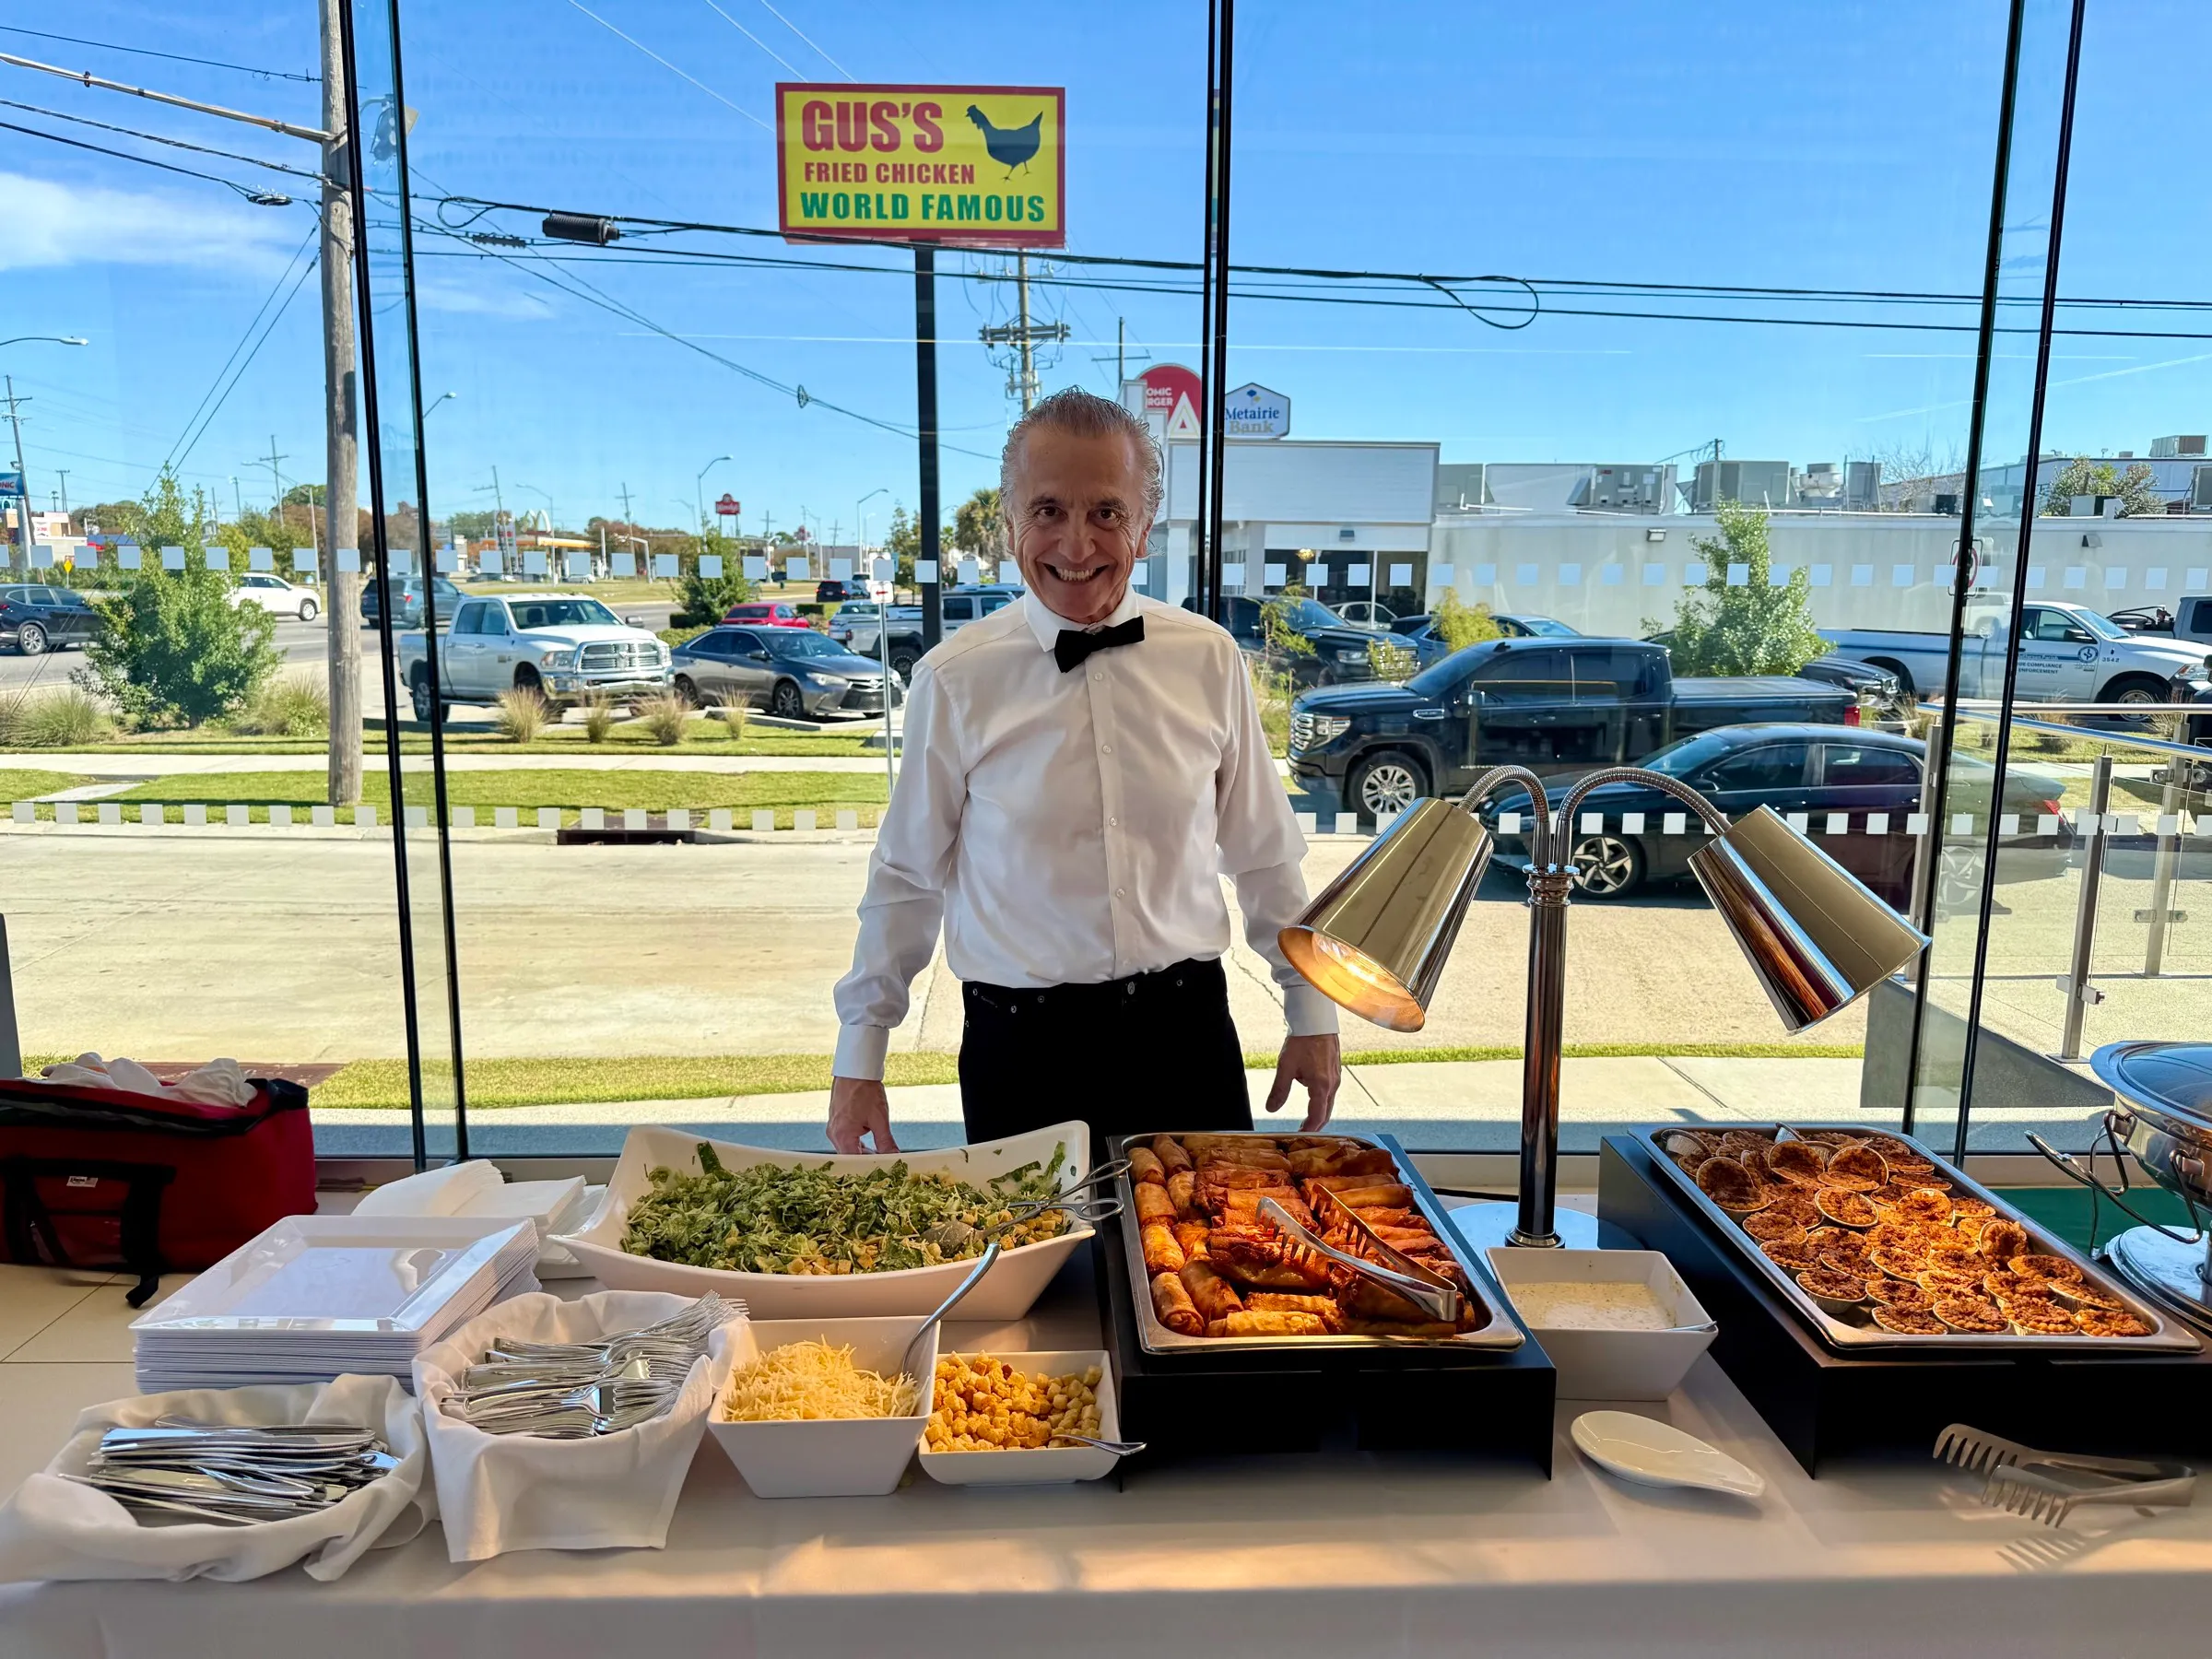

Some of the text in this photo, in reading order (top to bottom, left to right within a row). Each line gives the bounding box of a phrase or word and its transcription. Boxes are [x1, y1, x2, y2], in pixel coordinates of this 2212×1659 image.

[802, 100, 944, 152] GUS'S
[805, 162, 975, 184] FRIED CHICKEN
[801, 192, 1045, 222] WORLD FAMOUS
[1225, 407, 1280, 420] Metairie
[1230, 420, 1276, 433] Bank
